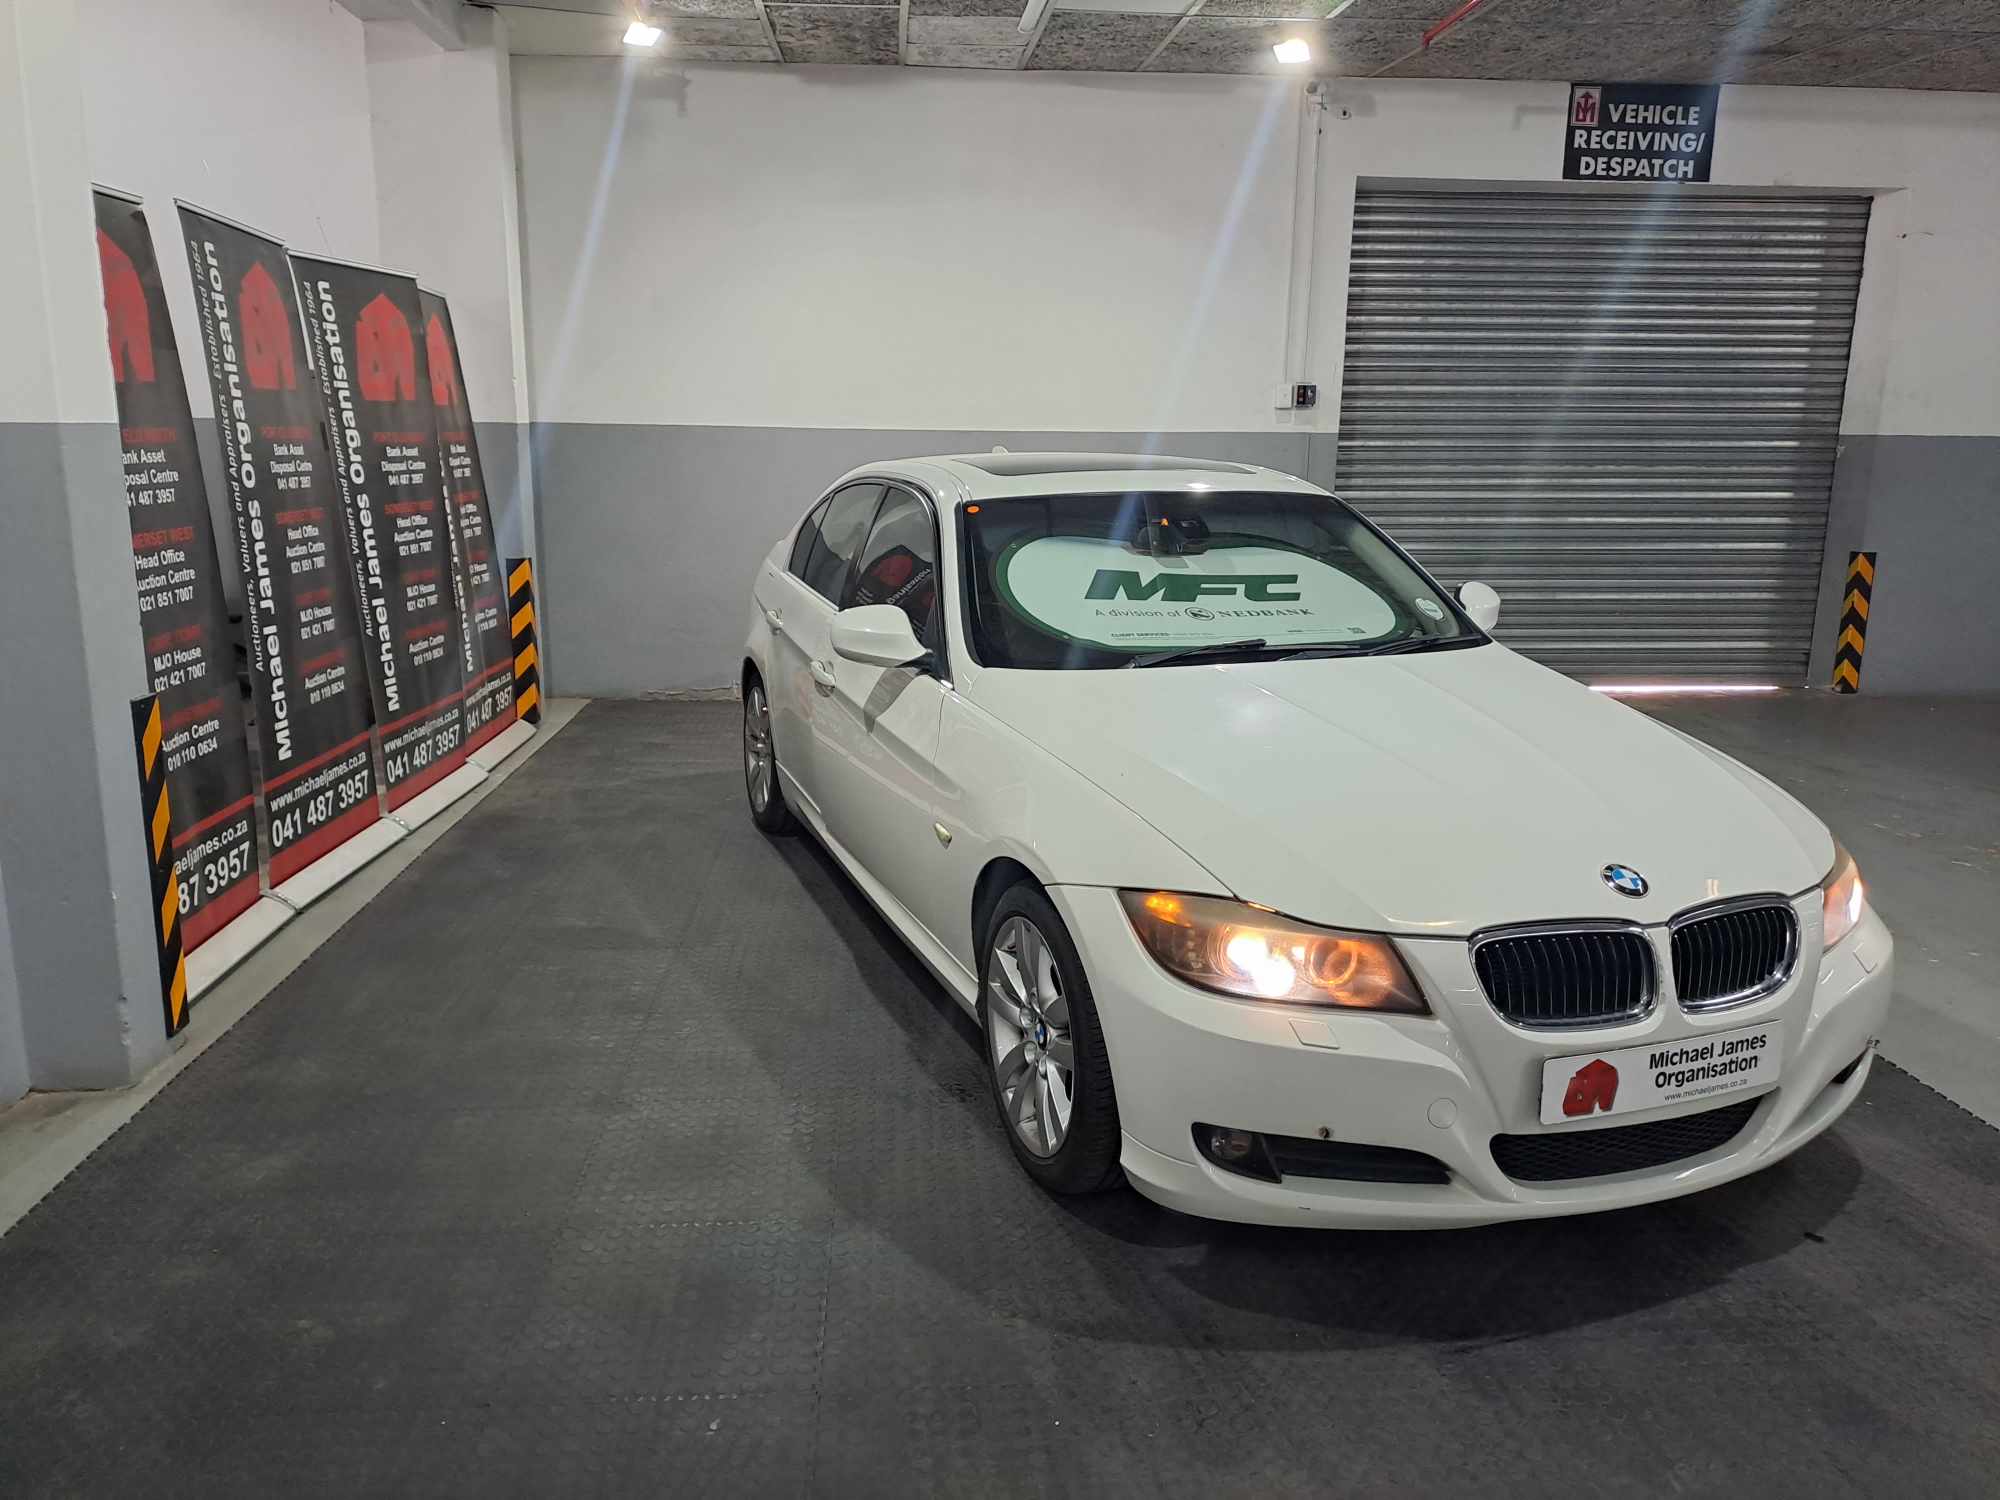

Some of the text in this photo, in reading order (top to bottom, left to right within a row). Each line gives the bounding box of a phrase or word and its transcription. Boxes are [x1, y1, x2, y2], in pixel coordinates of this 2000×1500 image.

[1609, 104, 1699, 125] VEHICLE
[1573, 129, 1706, 152] RECEIVING/
[1579, 156, 1695, 178] DESPATCH
[219, 394, 239, 477] Appraisers
[122, 448, 166, 464] ank Asset
[124, 468, 179, 489] posal Centre
[340, 478, 351, 503] and
[138, 490, 153, 505] 487
[204, 240, 293, 761] Michael James Organisation
[230, 481, 244, 512] and
[317, 280, 401, 712] Michael James Organisation
[239, 517, 252, 573] Valuers
[134, 549, 185, 570] Head Office
[168, 568, 196, 584] Centre
[1084, 569, 1301, 602] MFC
[140, 585, 193, 612] 021 851 7007
[1095, 608, 1314, 617] A division of NEDBANK
[153, 646, 202, 672] MJO House
[154, 676, 169, 692] 021
[170, 670, 185, 686] 421
[466, 685, 513, 733] 041 487 3957
[191, 719, 220, 739] Centre
[387, 724, 460, 783] 041 487 3957
[272, 769, 368, 847] 041 487 3957
[174, 820, 248, 875] aeljames.co.za
[178, 841, 250, 914] 87 3957
[1649, 1034, 1767, 1069] Michael James
[1655, 1055, 1759, 1088] Organisation
